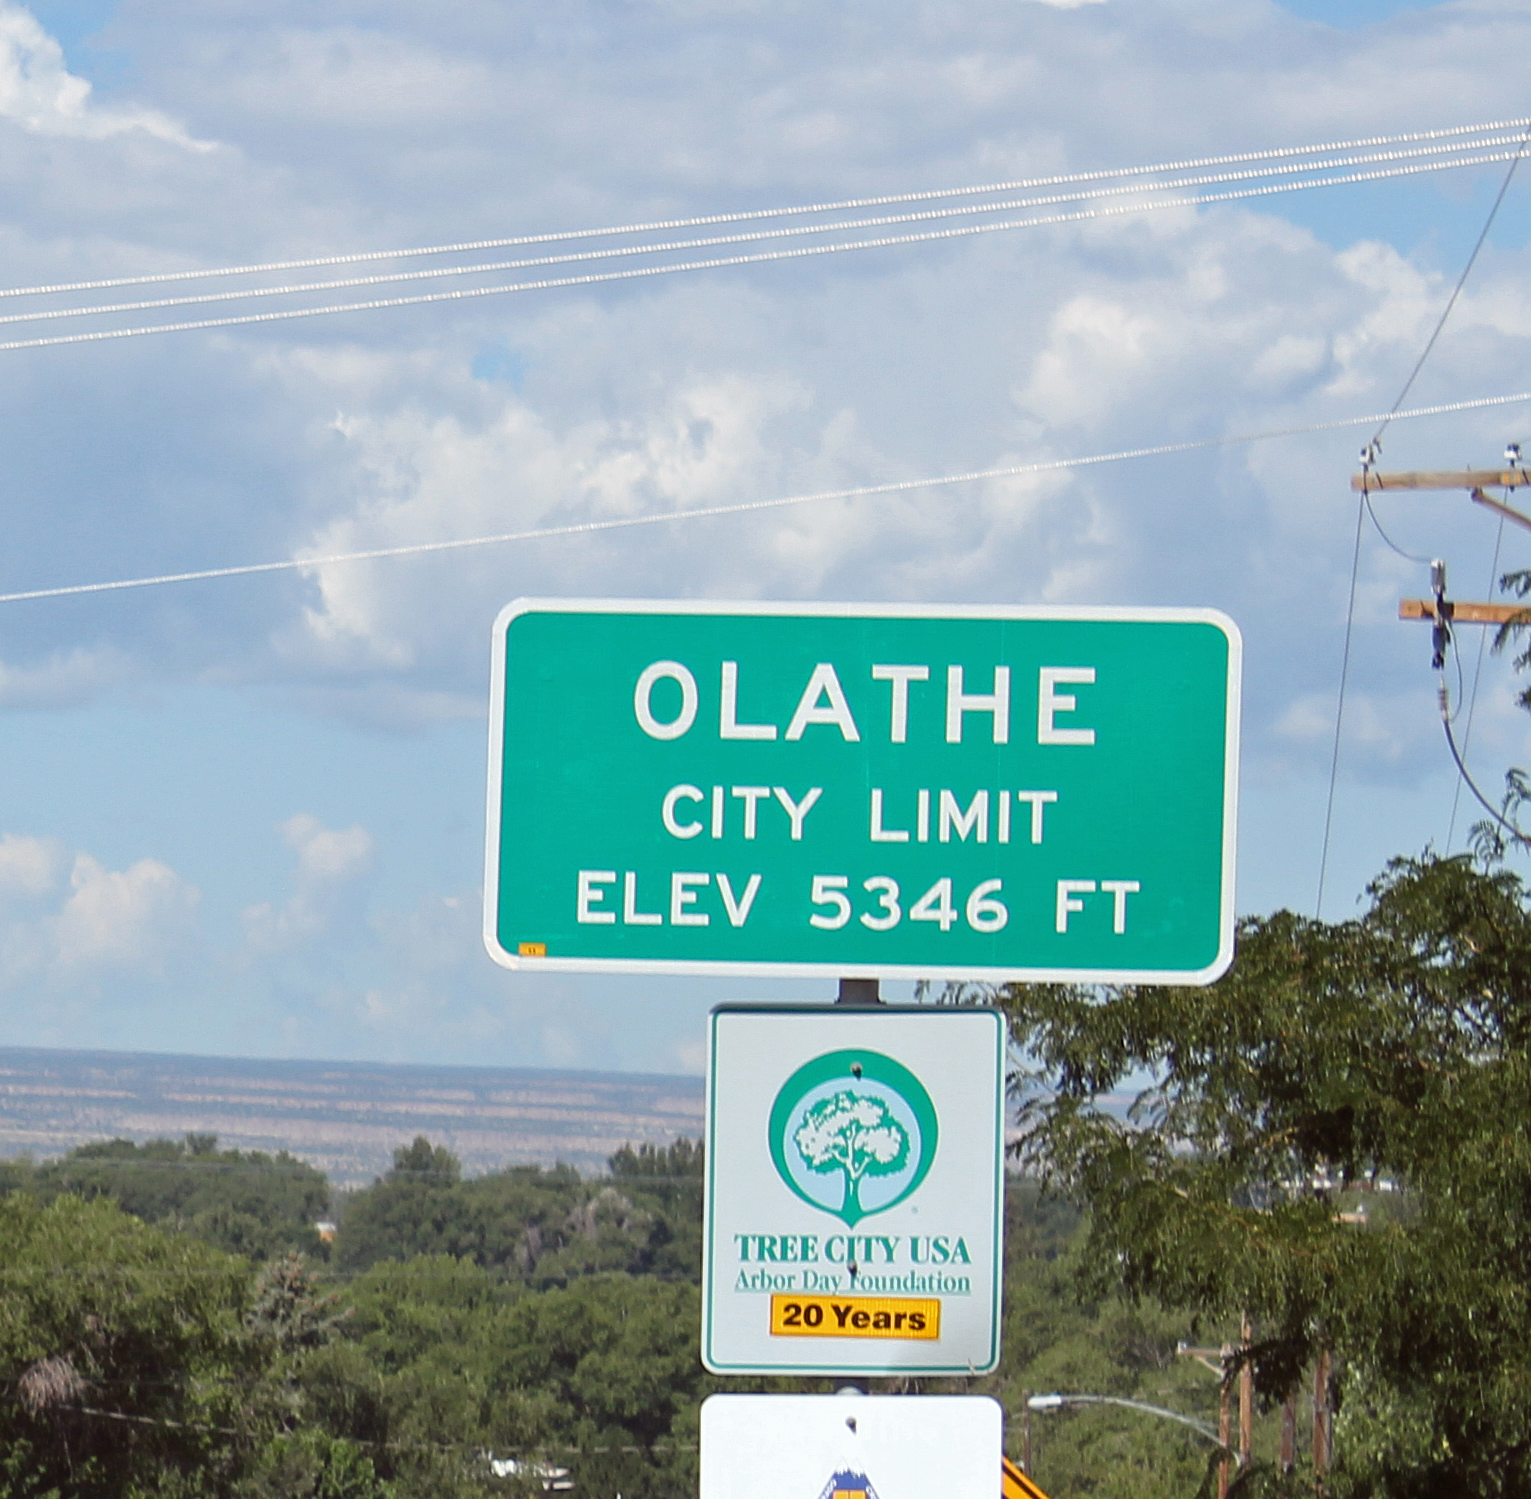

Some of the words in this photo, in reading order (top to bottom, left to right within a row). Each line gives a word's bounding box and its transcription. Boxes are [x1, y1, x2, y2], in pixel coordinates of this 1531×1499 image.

[633, 660, 1097, 745] OLATHE
[661, 784, 823, 841] CITY
[869, 789, 1058, 845] LIMIT
[576, 870, 763, 928] ELEV
[809, 876, 1009, 934] 5346
[1055, 880, 1141, 936] FT
[734, 1234, 819, 1264] TREE
[825, 1236, 901, 1265] CITY
[910, 1236, 973, 1265] USA
[735, 1268, 797, 1292] Arbor
[803, 1270, 842, 1297] Day
[850, 1270, 972, 1293] Foundation
[782, 1303, 824, 1327] 20
[832, 1305, 927, 1331] Years
